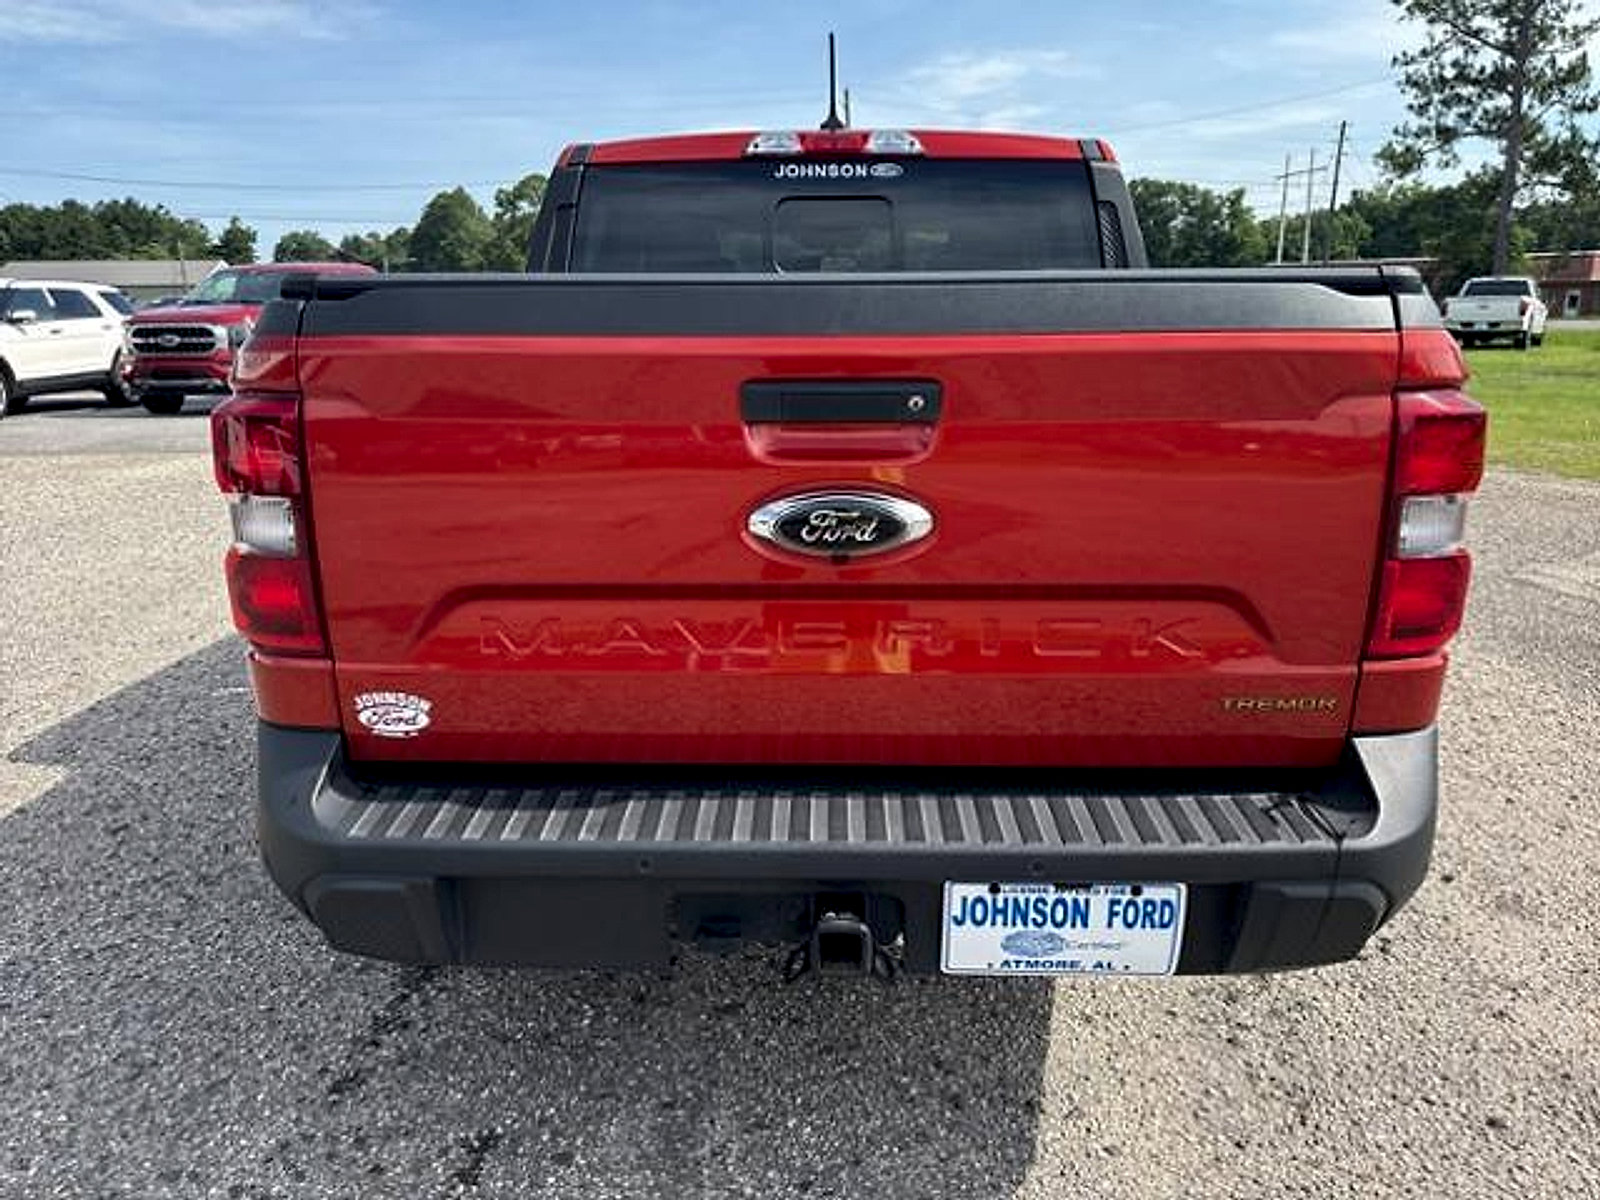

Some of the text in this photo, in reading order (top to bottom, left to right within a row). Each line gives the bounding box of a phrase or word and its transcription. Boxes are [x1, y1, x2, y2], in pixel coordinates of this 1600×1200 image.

[775, 163, 867, 178] JOHNSON
[799, 510, 879, 542] Ford
[478, 615, 1205, 659] MAVERICK
[353, 691, 433, 712] JOHNSON
[1220, 697, 1337, 713] TREMOR
[952, 896, 1175, 929] JOHNSON FORD
